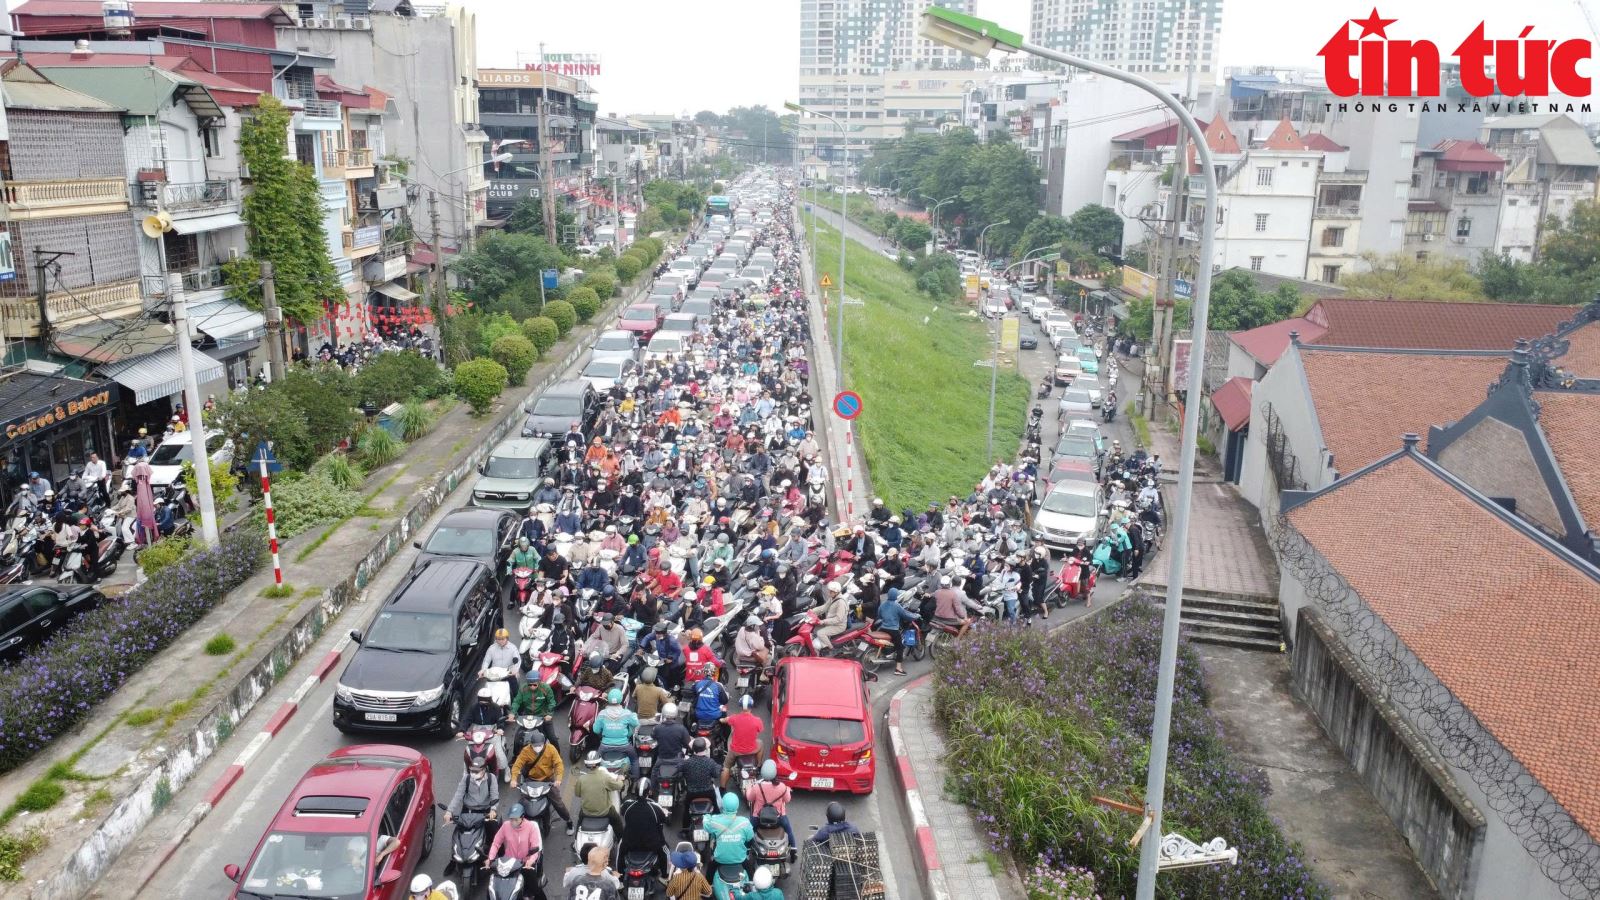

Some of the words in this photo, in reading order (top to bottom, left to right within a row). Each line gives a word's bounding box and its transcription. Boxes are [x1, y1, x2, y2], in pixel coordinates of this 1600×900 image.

[563, 64, 601, 76] NINH
[6, 413, 54, 439] Coffee
[55, 406, 66, 420] &
[68, 390, 109, 416] Bakery
[574, 884, 603, 900] 84
